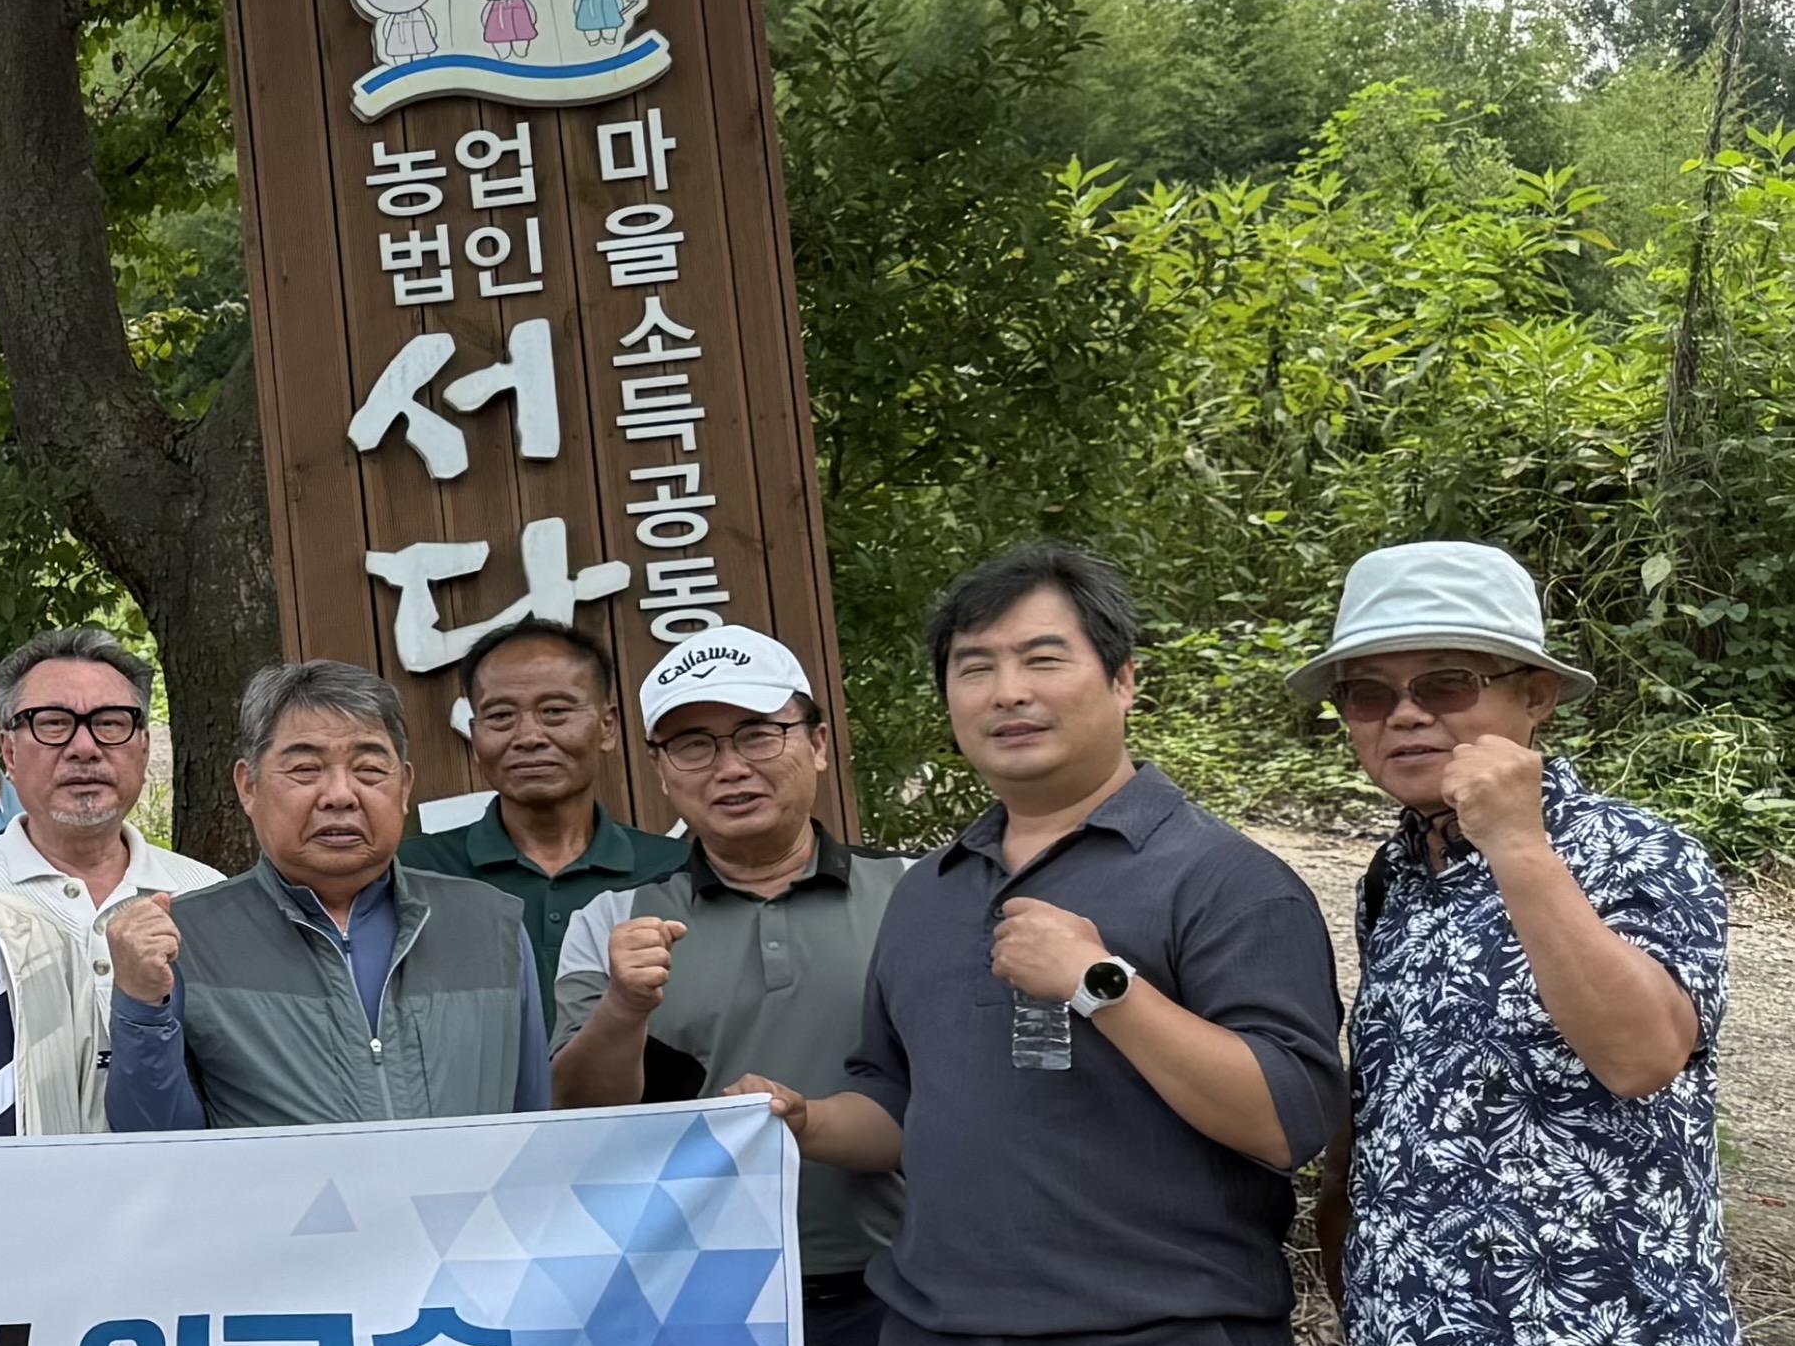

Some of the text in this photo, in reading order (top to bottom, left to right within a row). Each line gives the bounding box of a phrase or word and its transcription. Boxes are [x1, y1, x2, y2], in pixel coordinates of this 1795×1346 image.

[366, 122, 536, 217] 농업
[379, 217, 544, 306] 법인
[596, 108, 730, 645] 마을소득공동
[657, 646, 751, 685] Callaway
